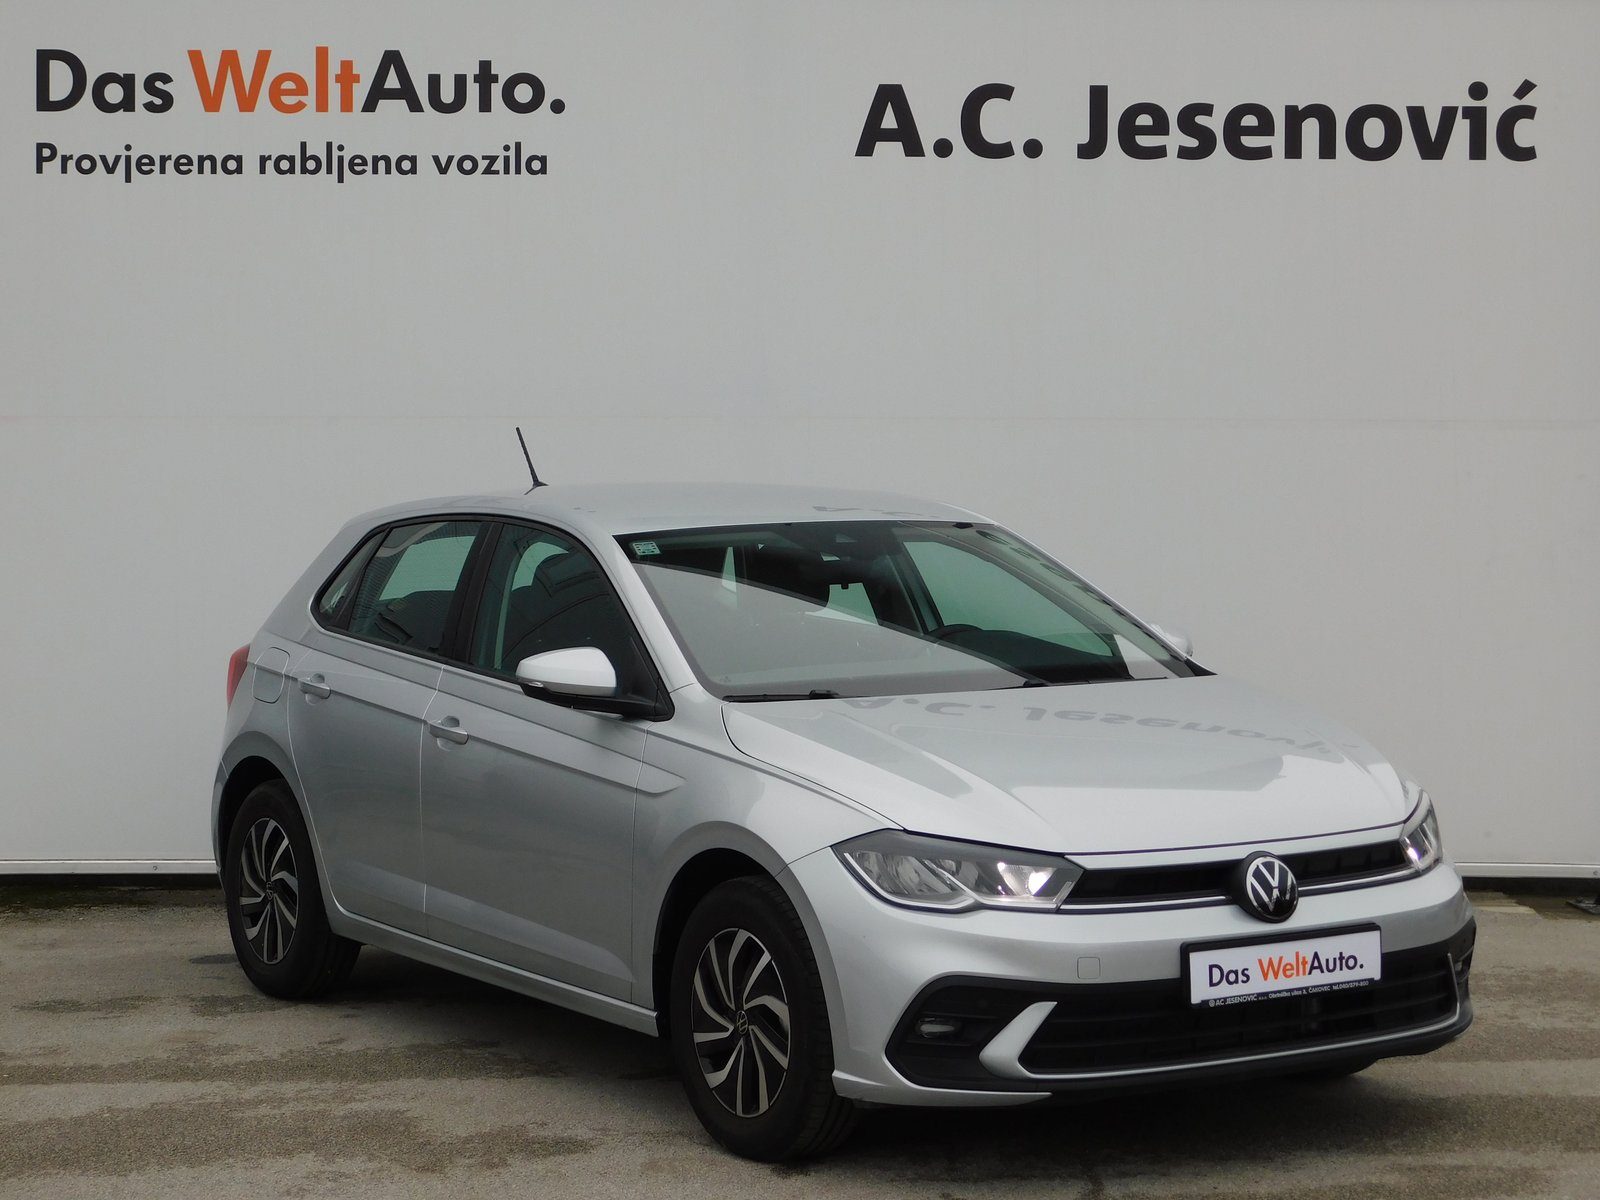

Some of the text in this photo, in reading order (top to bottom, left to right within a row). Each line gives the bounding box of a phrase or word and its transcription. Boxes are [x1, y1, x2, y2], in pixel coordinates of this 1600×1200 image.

[36, 46, 566, 115] Das WeltAuto.
[855, 79, 1538, 162] A.C. Jesenović
[36, 141, 548, 184] Provjerena rabljena vozila
[1208, 950, 1364, 988] Das WeltAuto.
